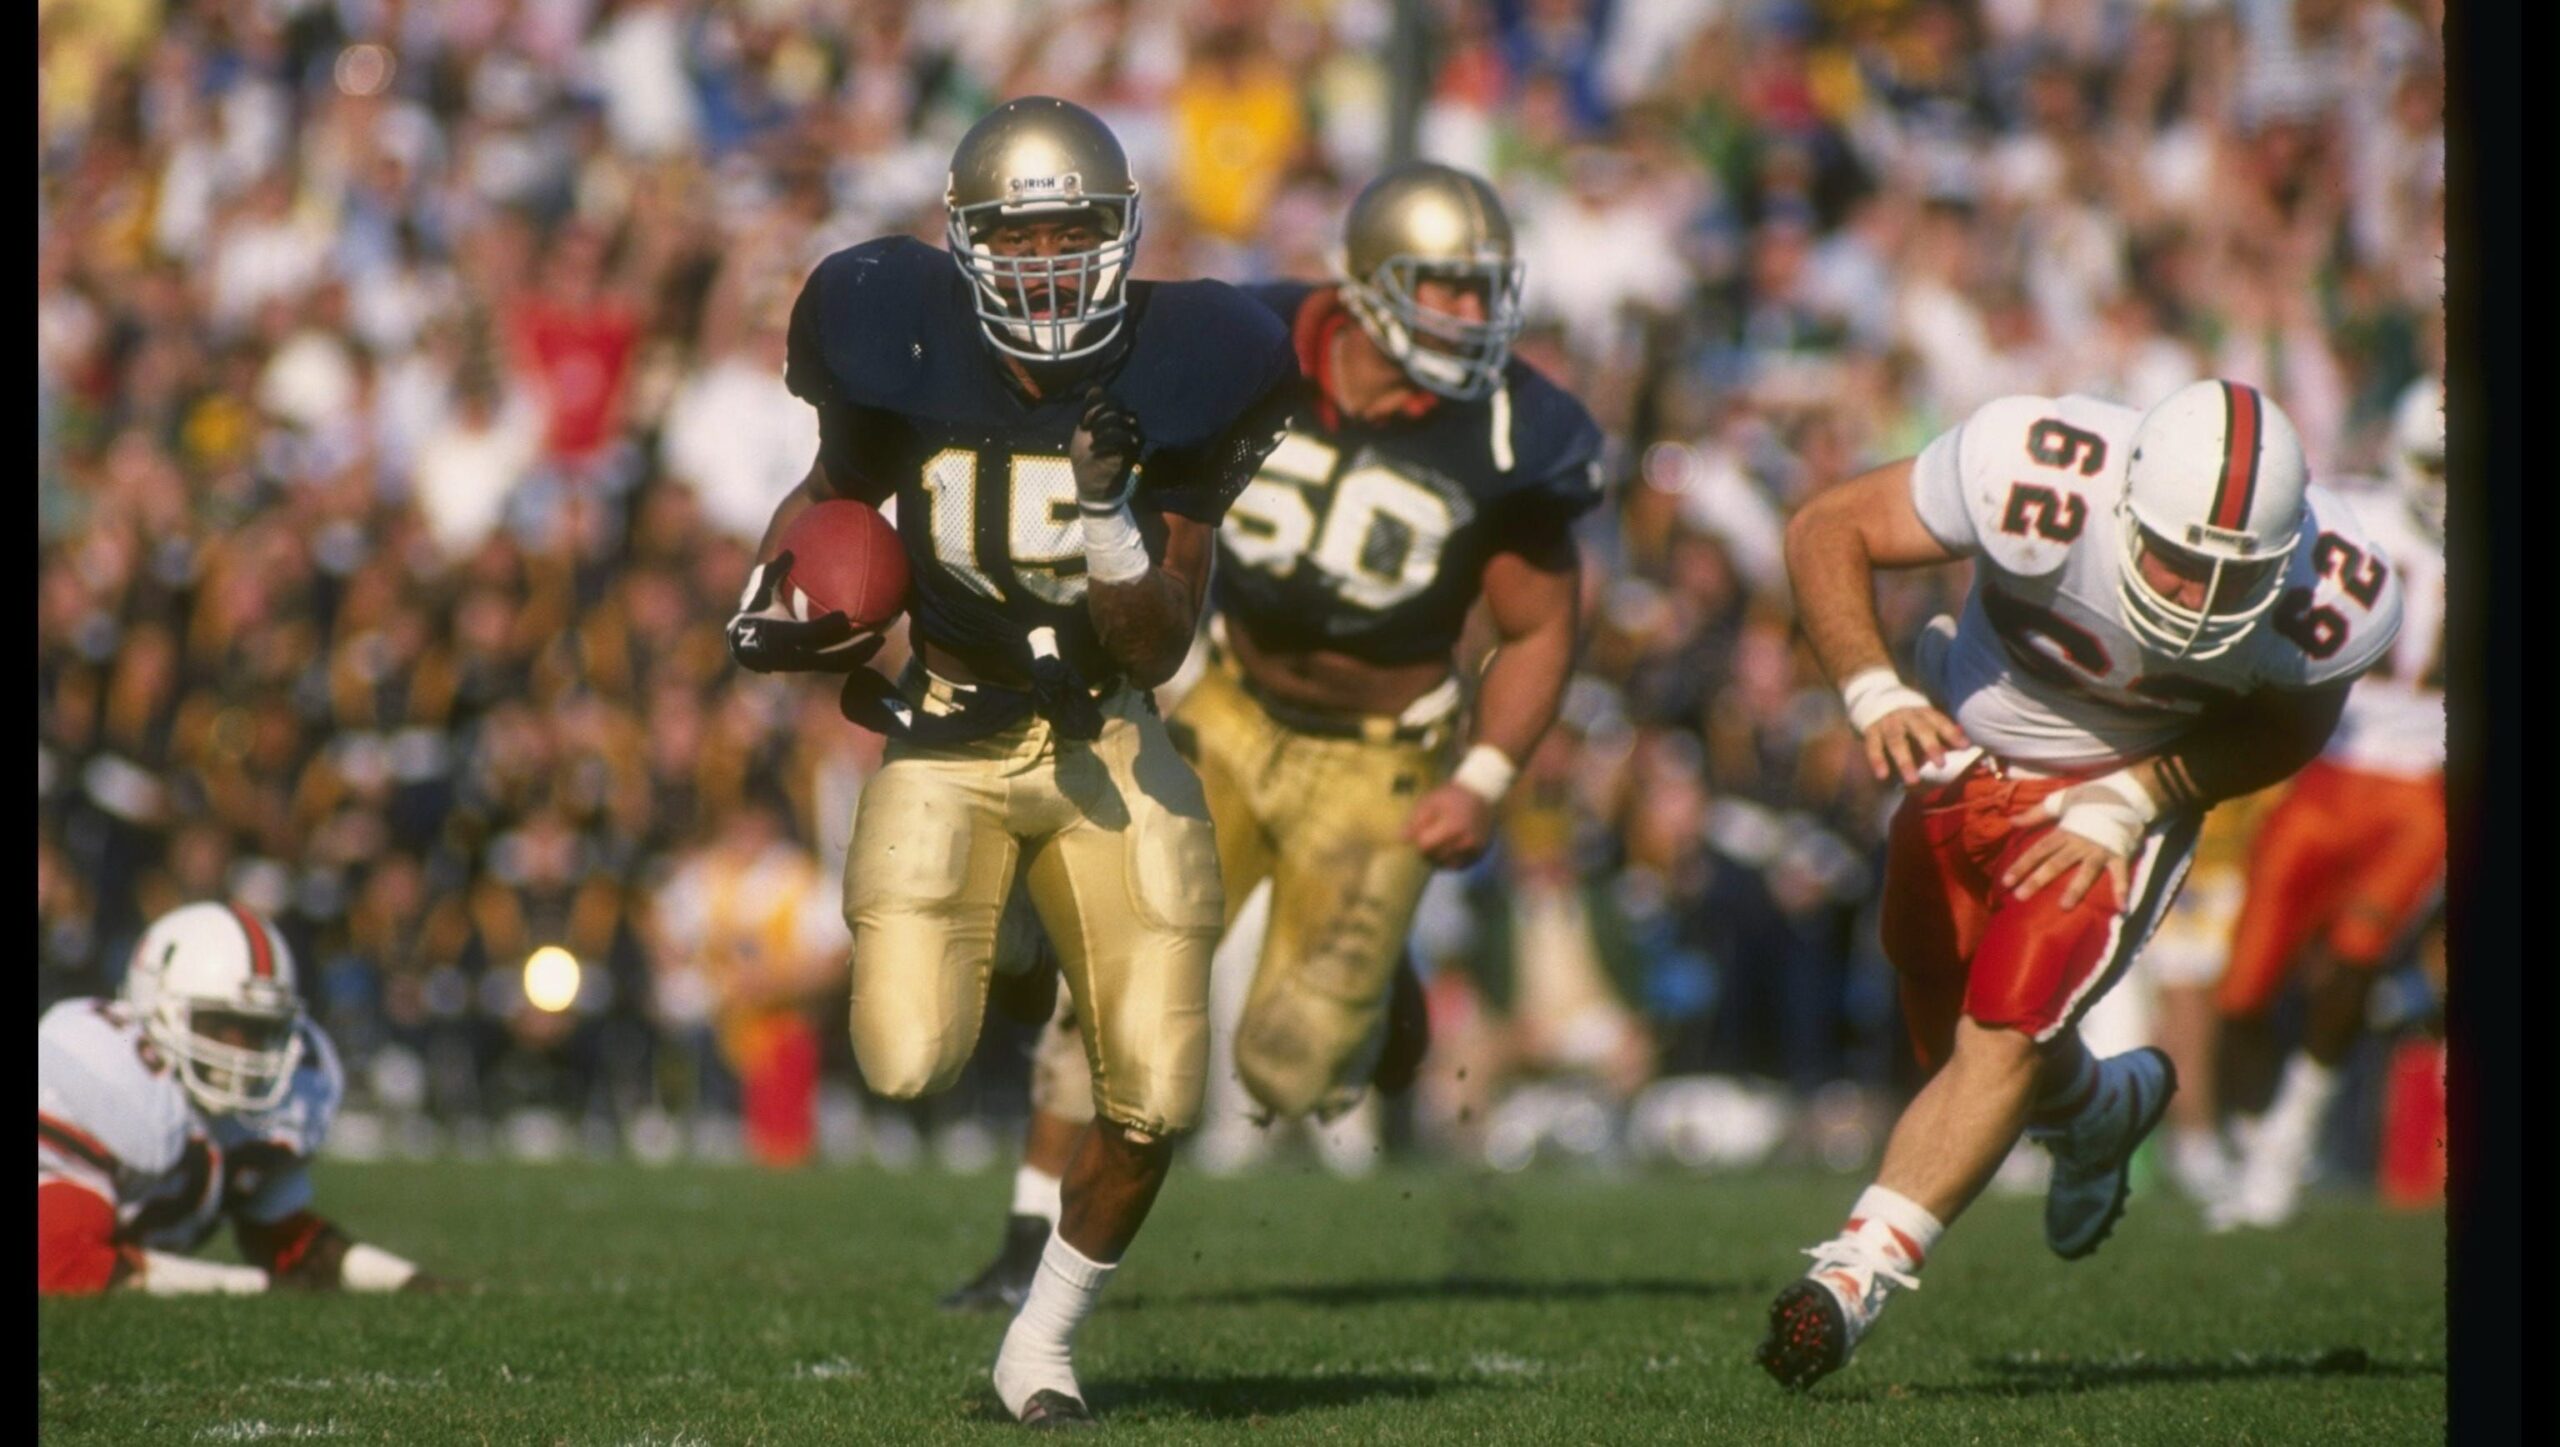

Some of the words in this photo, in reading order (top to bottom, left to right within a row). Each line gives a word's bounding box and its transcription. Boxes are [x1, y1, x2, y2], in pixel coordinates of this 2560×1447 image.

[1024, 177, 1056, 189] IRISH
[921, 447, 1143, 606] 15
[2002, 418, 2107, 546] 62
[2272, 531, 2388, 661] 62
